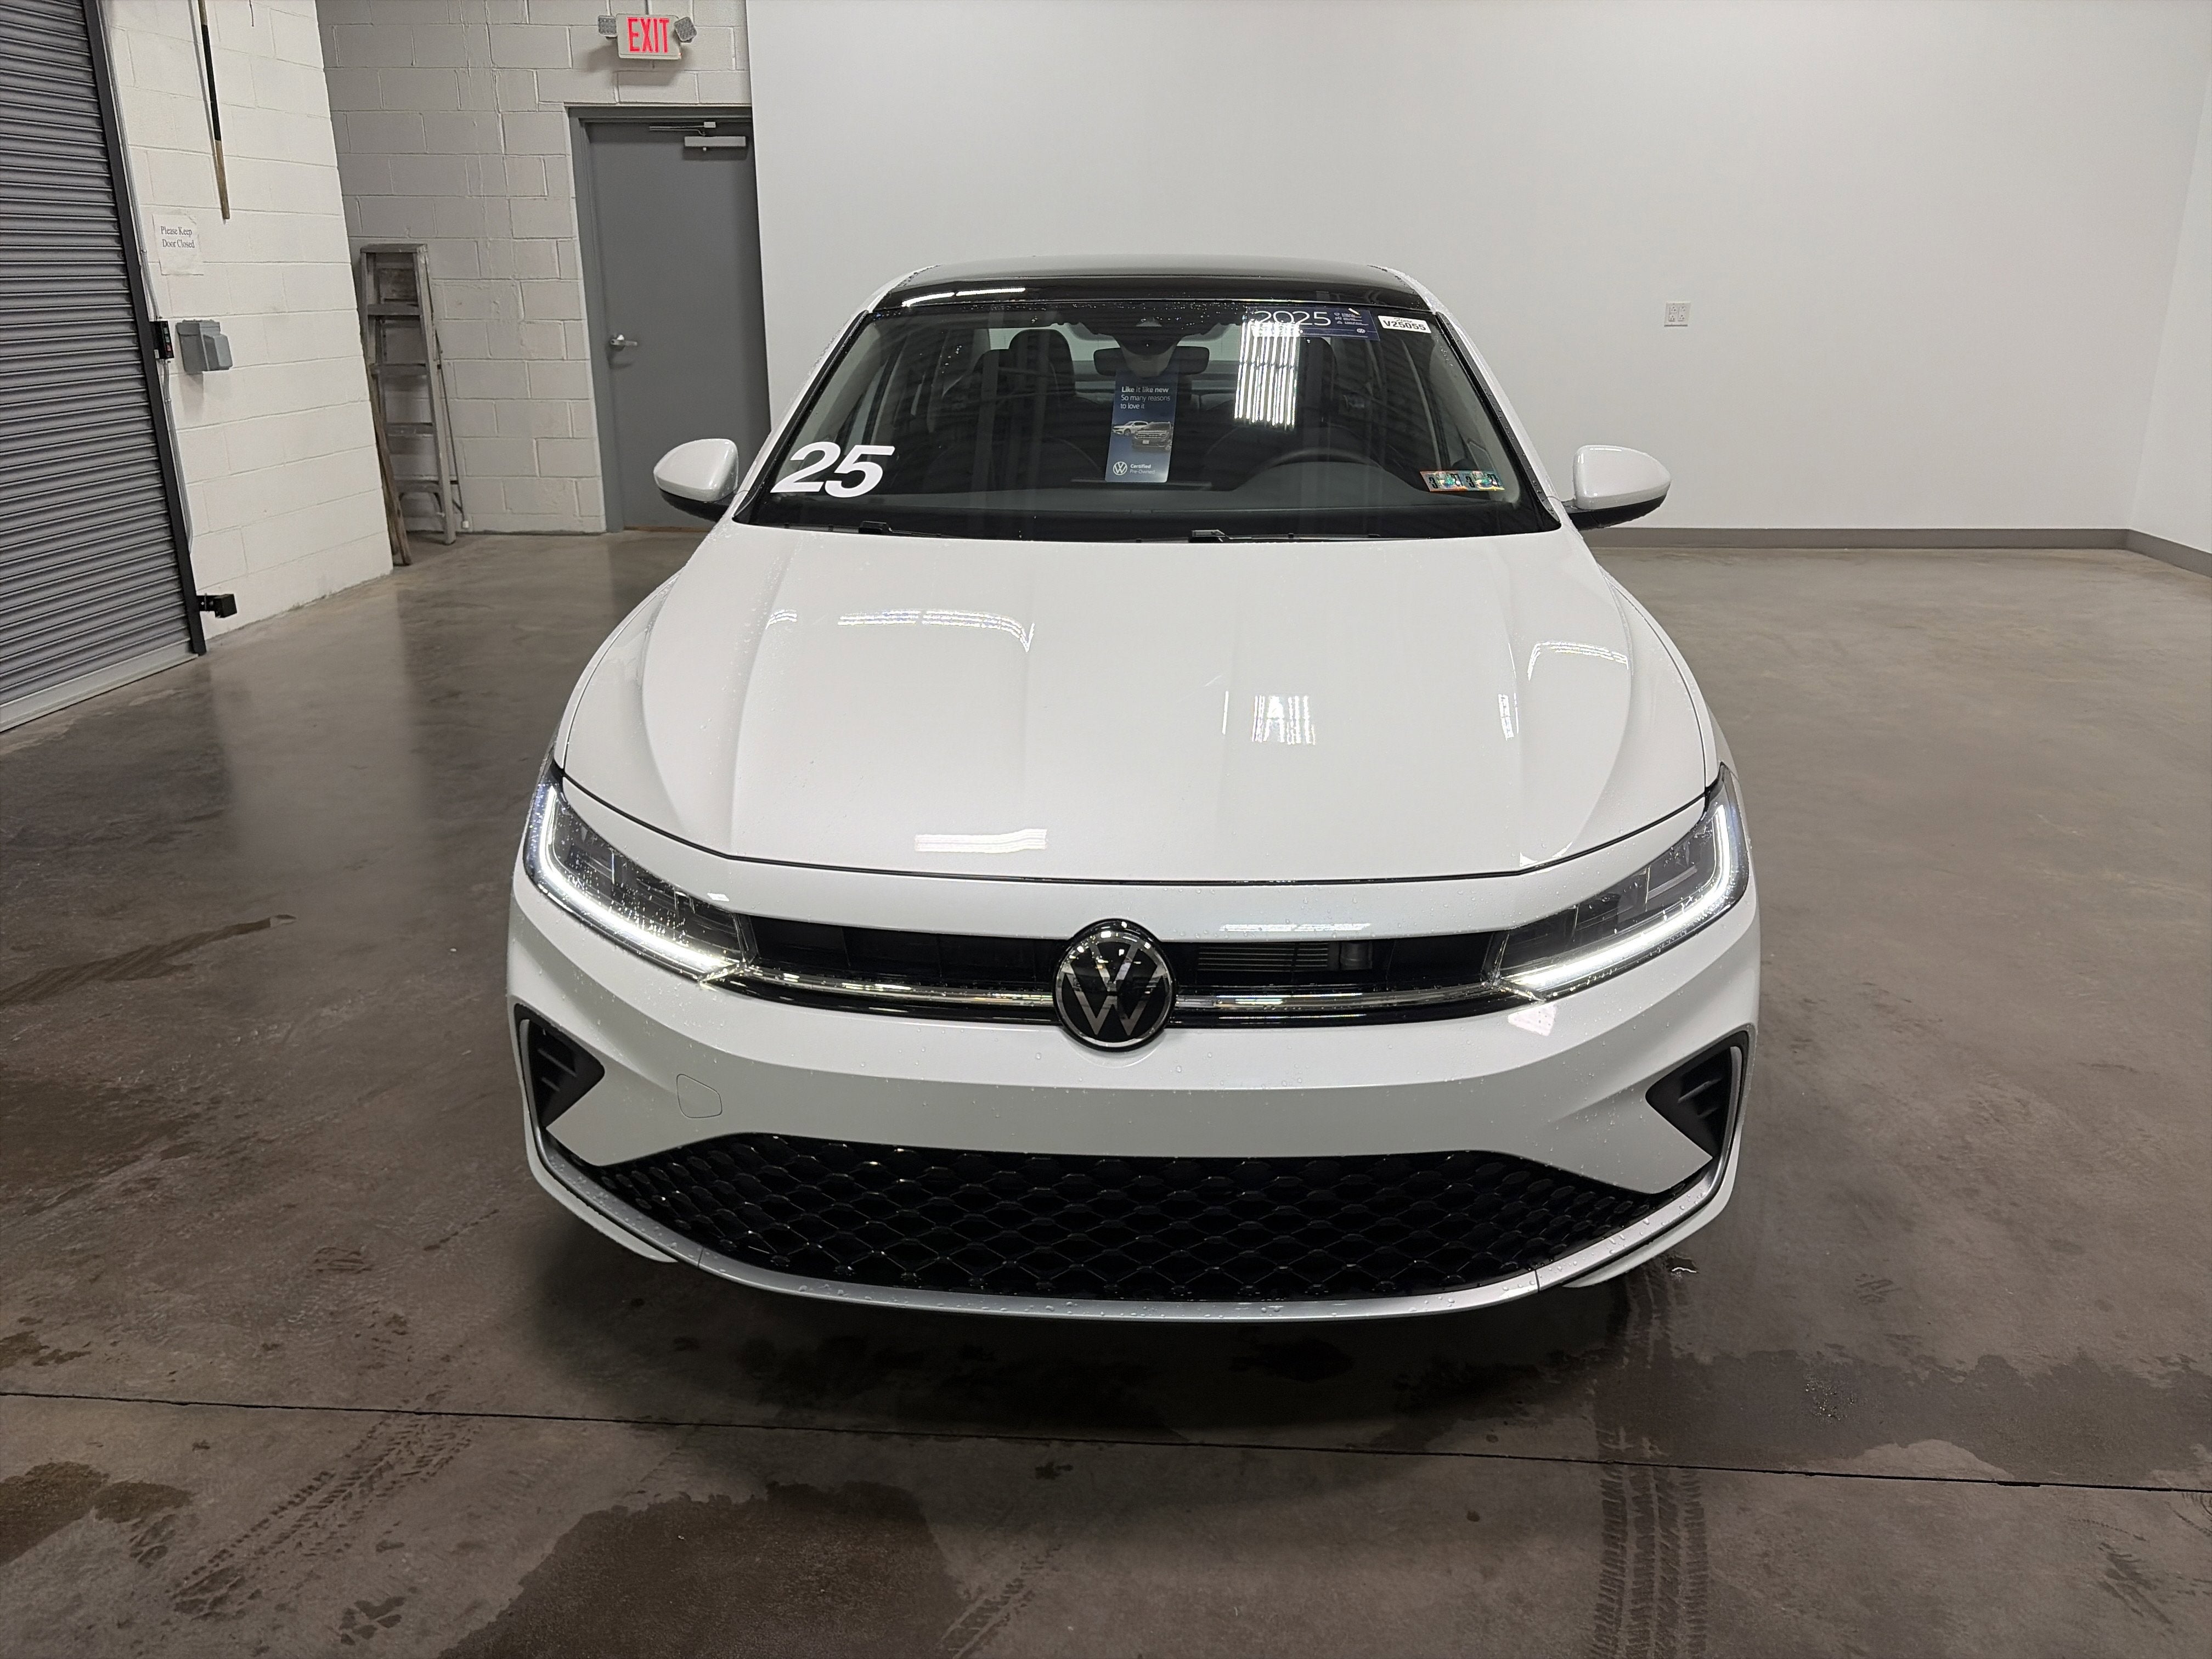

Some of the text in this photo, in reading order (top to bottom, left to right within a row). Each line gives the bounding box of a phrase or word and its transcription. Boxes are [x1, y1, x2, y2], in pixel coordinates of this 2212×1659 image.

[627, 16, 670, 53] EXIT
[161, 225, 193, 238] Please Keep
[162, 239, 195, 249] Door Closed
[1253, 311, 1331, 326] 2025
[1383, 320, 1426, 331] V25055
[770, 441, 896, 498] 25
[1429, 477, 1438, 489] 3
[1465, 476, 1476, 488] 3
